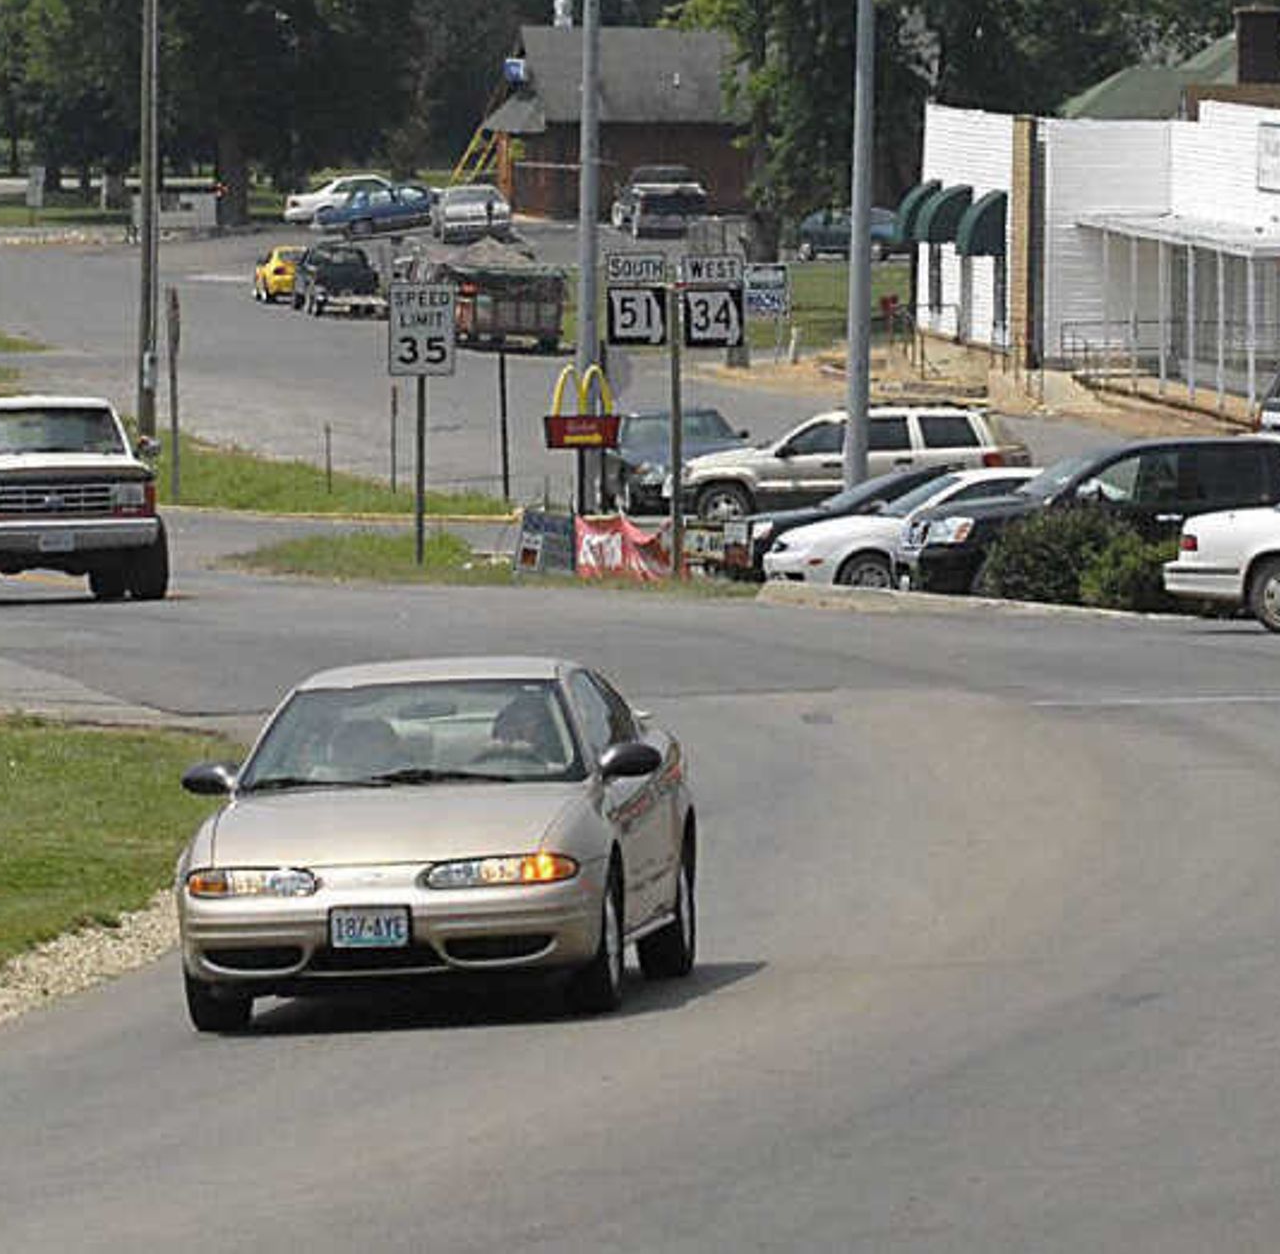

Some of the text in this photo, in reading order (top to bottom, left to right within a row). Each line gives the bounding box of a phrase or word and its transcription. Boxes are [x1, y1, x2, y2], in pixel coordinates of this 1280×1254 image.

[610, 257, 663, 278] SOUTH
[691, 260, 737, 279] WEST
[394, 292, 449, 306] SPEED
[400, 312, 442, 328] LIMIT
[620, 297, 653, 329] 51
[693, 299, 732, 332] 34
[398, 337, 447, 365] 35
